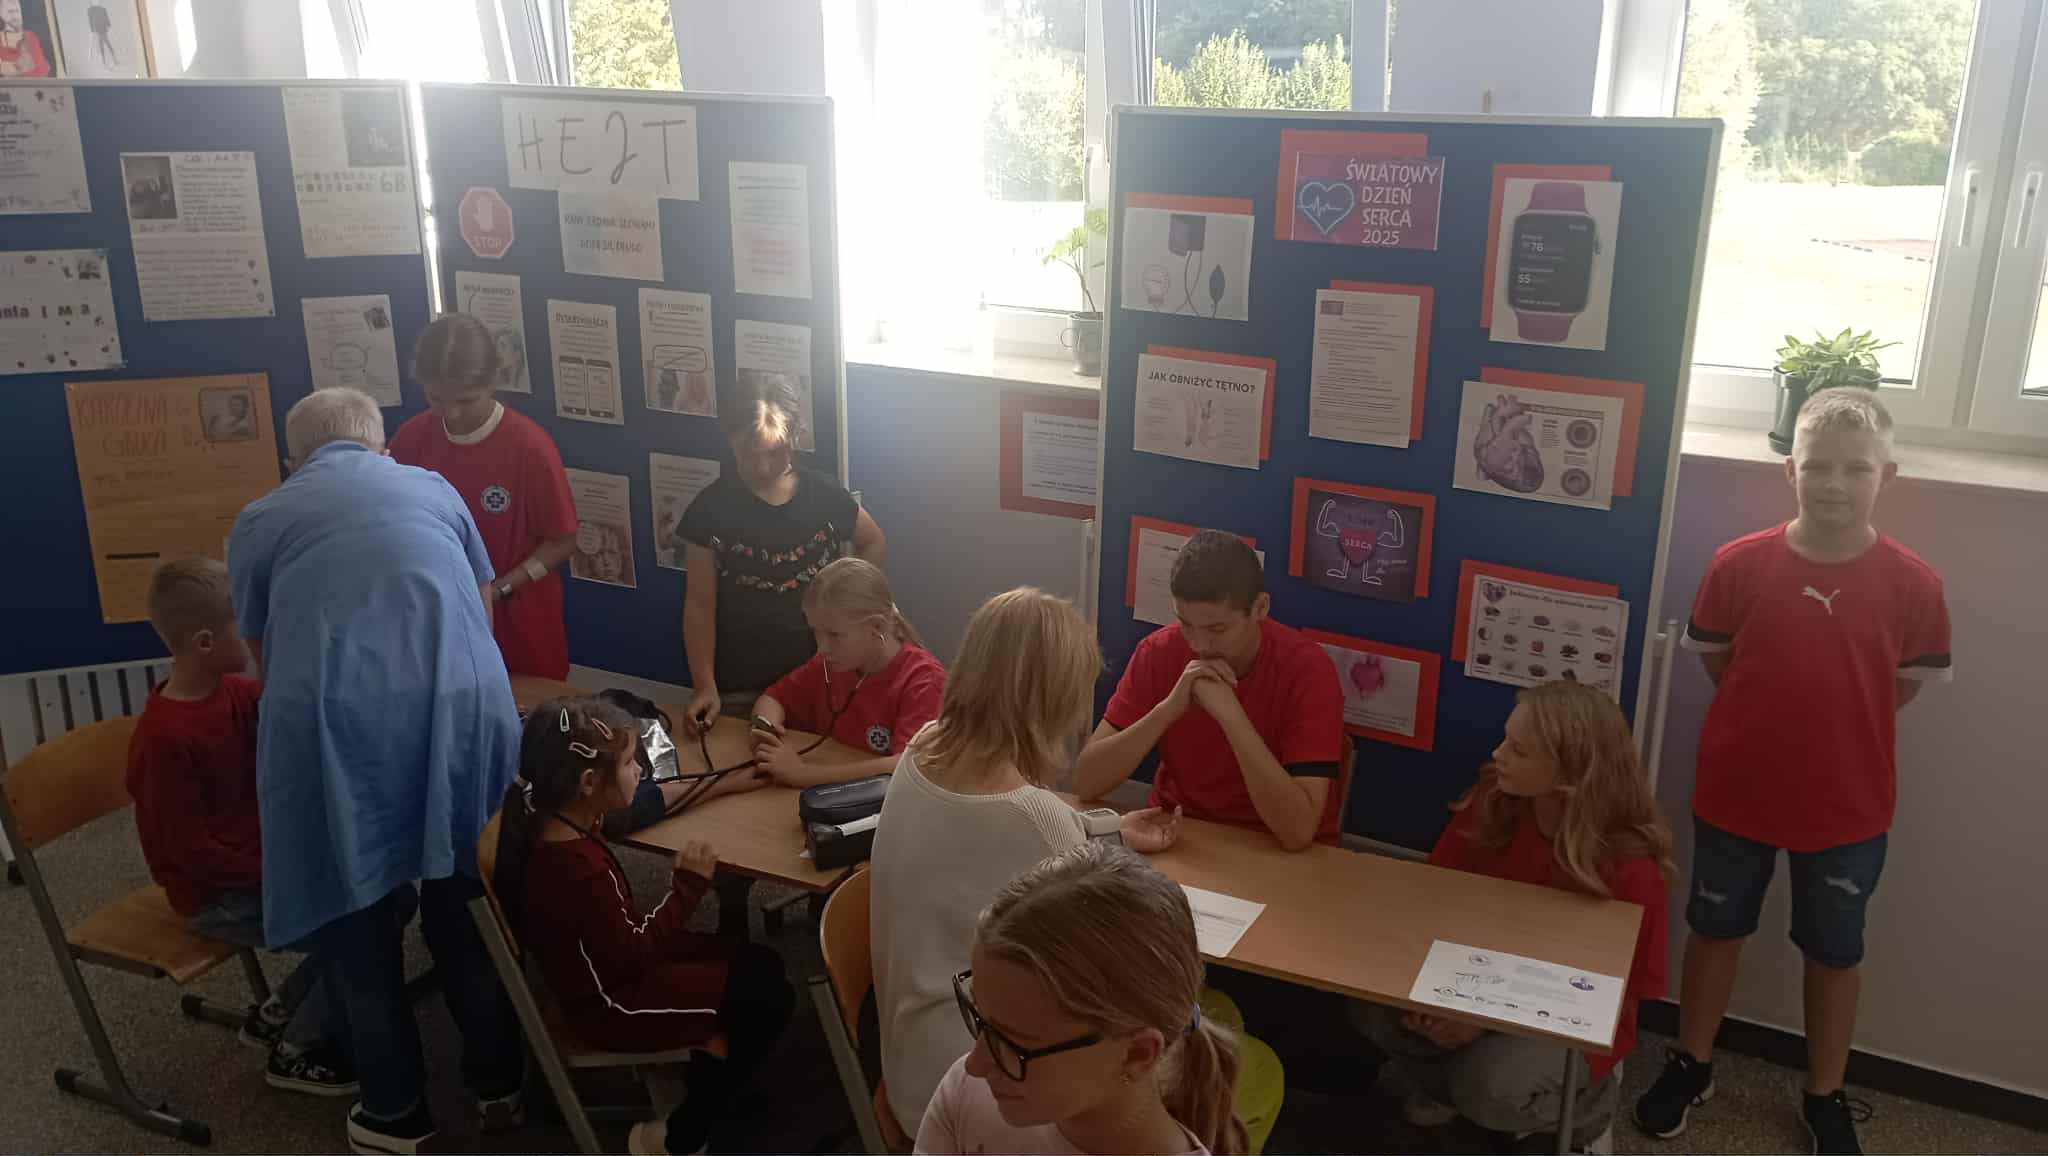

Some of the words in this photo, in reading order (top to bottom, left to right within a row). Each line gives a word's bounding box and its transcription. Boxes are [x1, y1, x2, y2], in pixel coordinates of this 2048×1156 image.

[1346, 158, 1439, 184] ŚWIATOWY
[1362, 181, 1412, 205] DZIEŃ
[1362, 208, 1412, 227] SERCA
[473, 235, 502, 250] STOP
[1362, 229, 1401, 245] 2025
[1148, 371, 1167, 383] JAK
[1169, 373, 1213, 389] OBNIŻYĆ
[1215, 380, 1256, 394] TĘTNO?
